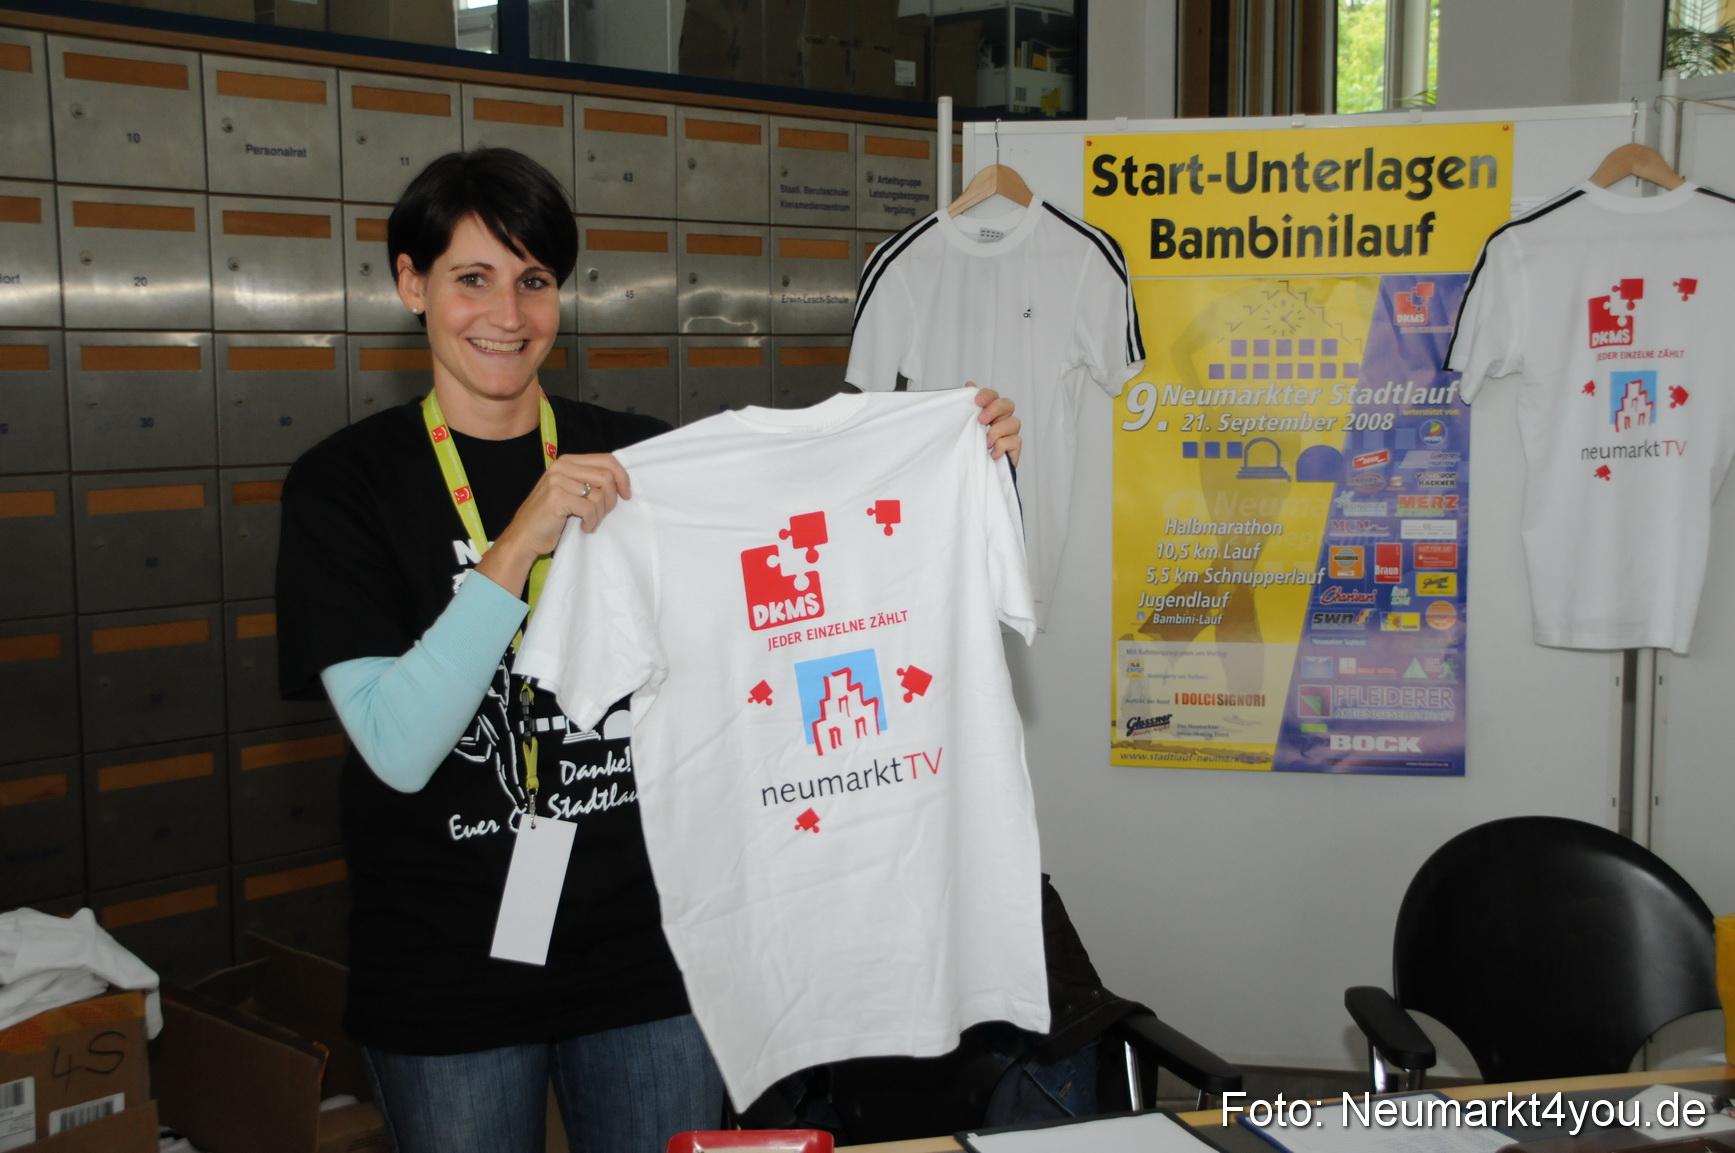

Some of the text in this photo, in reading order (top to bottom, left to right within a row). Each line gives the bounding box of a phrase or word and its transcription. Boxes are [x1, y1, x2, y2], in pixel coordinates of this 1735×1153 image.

[126, 132, 141, 144] 10
[245, 143, 307, 158] Personalrat
[400, 157, 410, 166] 11
[877, 175, 922, 187] Arbeitsgruppe
[1091, 147, 1498, 201] Start-Unterlagen
[804, 186, 849, 196] Berufsschule
[869, 189, 930, 202] Leistungsbezogene
[780, 201, 850, 211] Kreismedienzentrum
[883, 204, 916, 217] Vergütung
[1150, 211, 1436, 260] Bambinilauf
[0, 272, 20, 284] orf
[134, 276, 148, 287] 20
[781, 294, 849, 304] Erwin-Lesch-Schule
[1396, 313, 1425, 323] DKMS
[1591, 329, 1631, 346] DKMS
[1596, 348, 1685, 362] JEDER EINZELNE ZÄHLT
[1122, 380, 1460, 432] 9. Neumarkter Stadtlauf
[1403, 408, 1443, 416] unterstützt
[1181, 412, 1395, 437] 21. September 2008
[1399, 495, 1458, 510] MERZ
[1164, 518, 1283, 536] Halbmarathon
[1156, 542, 1262, 561] 10,5 km Lauf
[1145, 567, 1326, 588] 5,5 km Schnupperlauf
[1375, 565, 1399, 575] Braun
[1137, 591, 1231, 612] Jugendlauf
[753, 592, 820, 629] DKMS
[1313, 613, 1354, 624] swn
[1153, 613, 1223, 625] Bambini-Lauf
[768, 610, 908, 652] JEDER EINZELNE ZÄHLT
[1334, 686, 1455, 708] PFLEIDERER
[1126, 713, 1172, 737] Glossner
[1330, 734, 1422, 753] BOCK
[559, 745, 631, 785] Danke!
[761, 747, 942, 806] neumarktTV
[548, 782, 639, 820] Stadtlau
[450, 814, 500, 840] Euer
